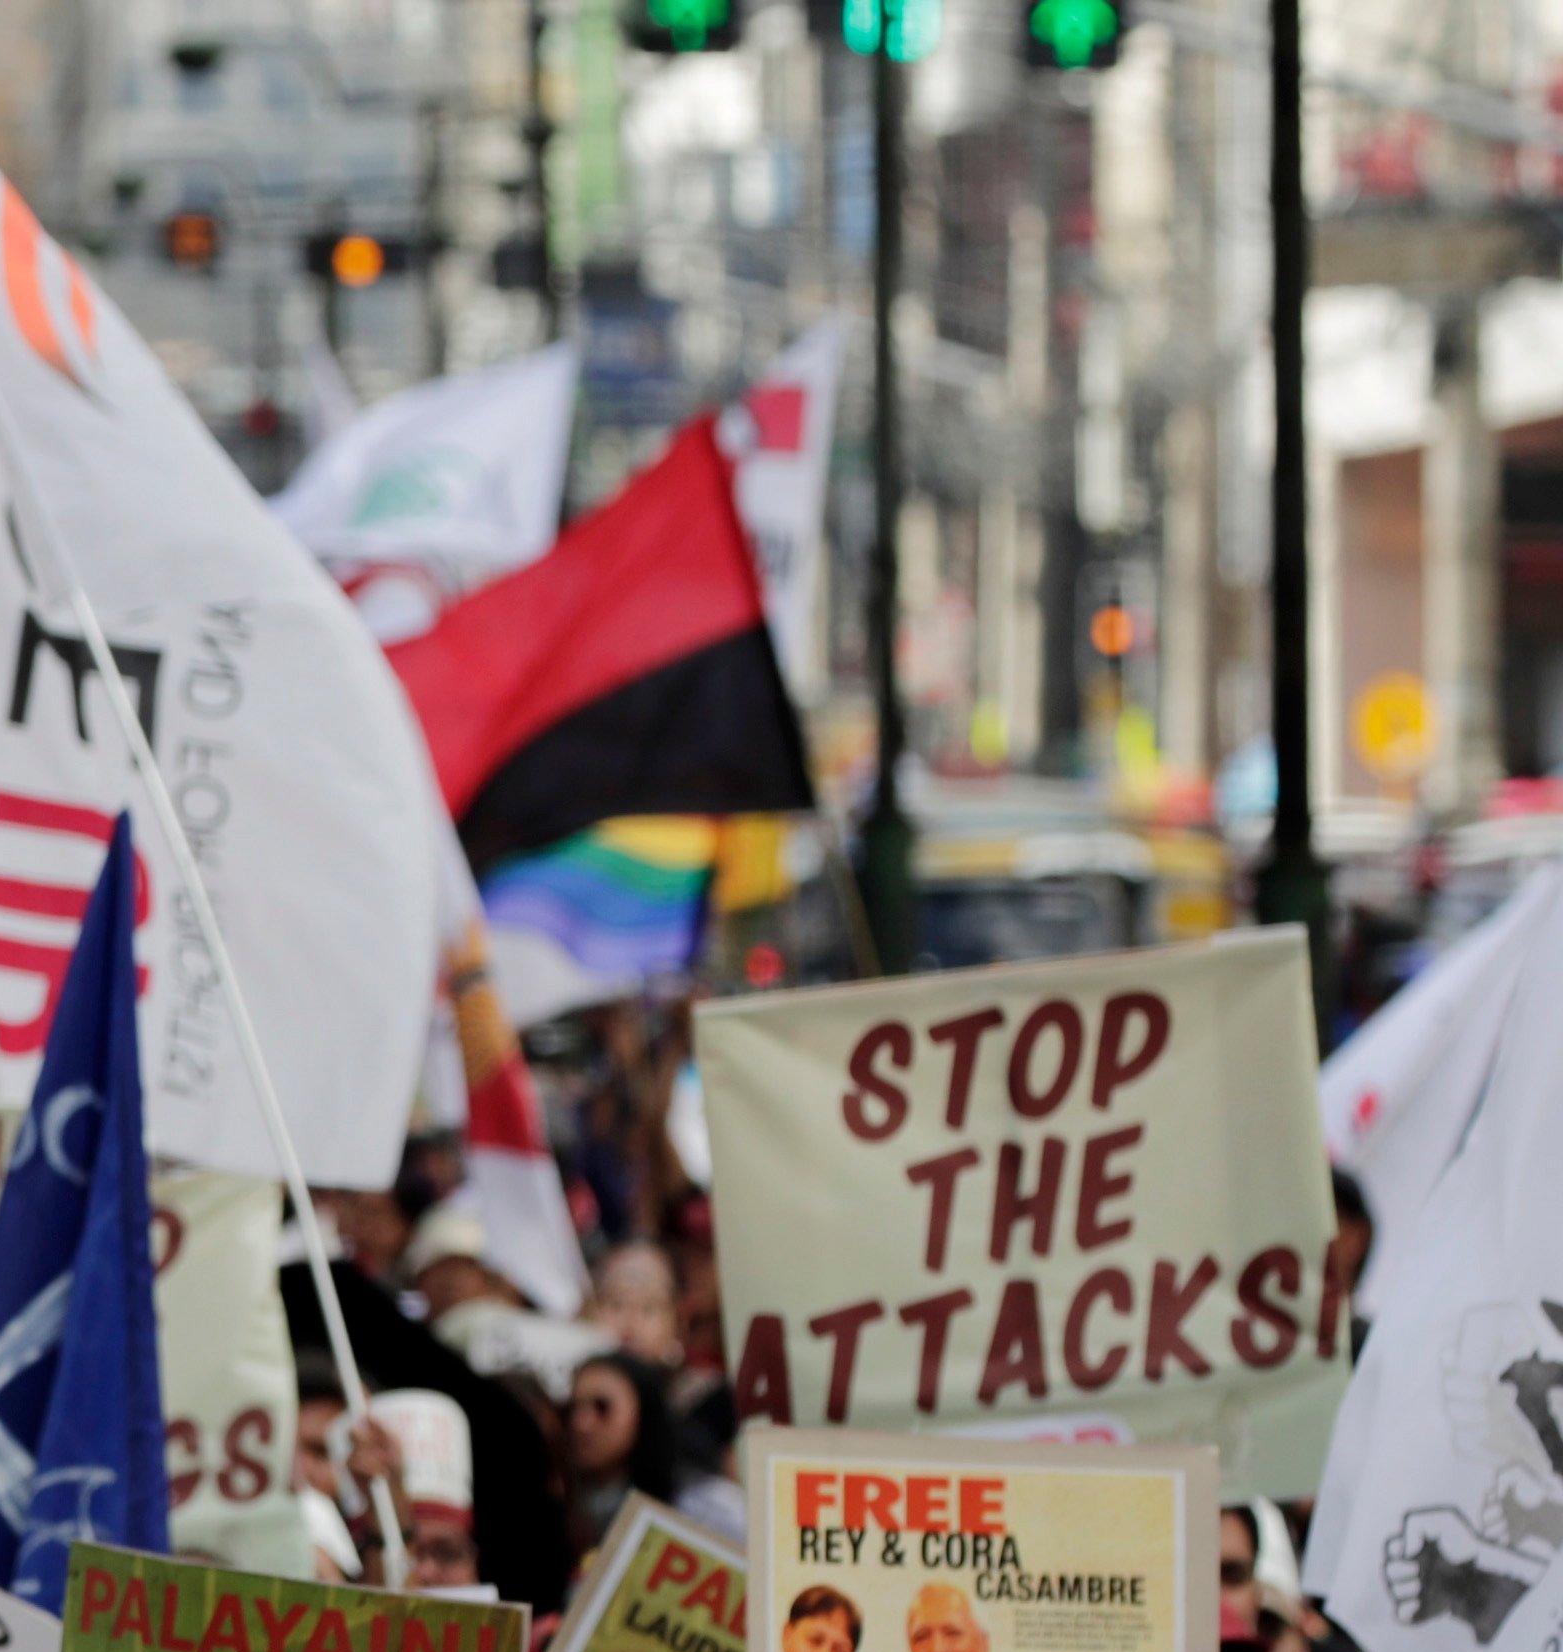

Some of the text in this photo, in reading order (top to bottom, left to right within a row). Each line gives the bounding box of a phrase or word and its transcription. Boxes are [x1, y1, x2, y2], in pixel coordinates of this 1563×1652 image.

[841, 992, 1171, 1142] STOP
[905, 1123, 1144, 1274] THE
[735, 1242, 1344, 1427] ATTACKS!
[795, 1472, 1006, 1535] FREE
[799, 1526, 1022, 1570] REY & CORA
[975, 1571, 1147, 1606] CASAMBRE
